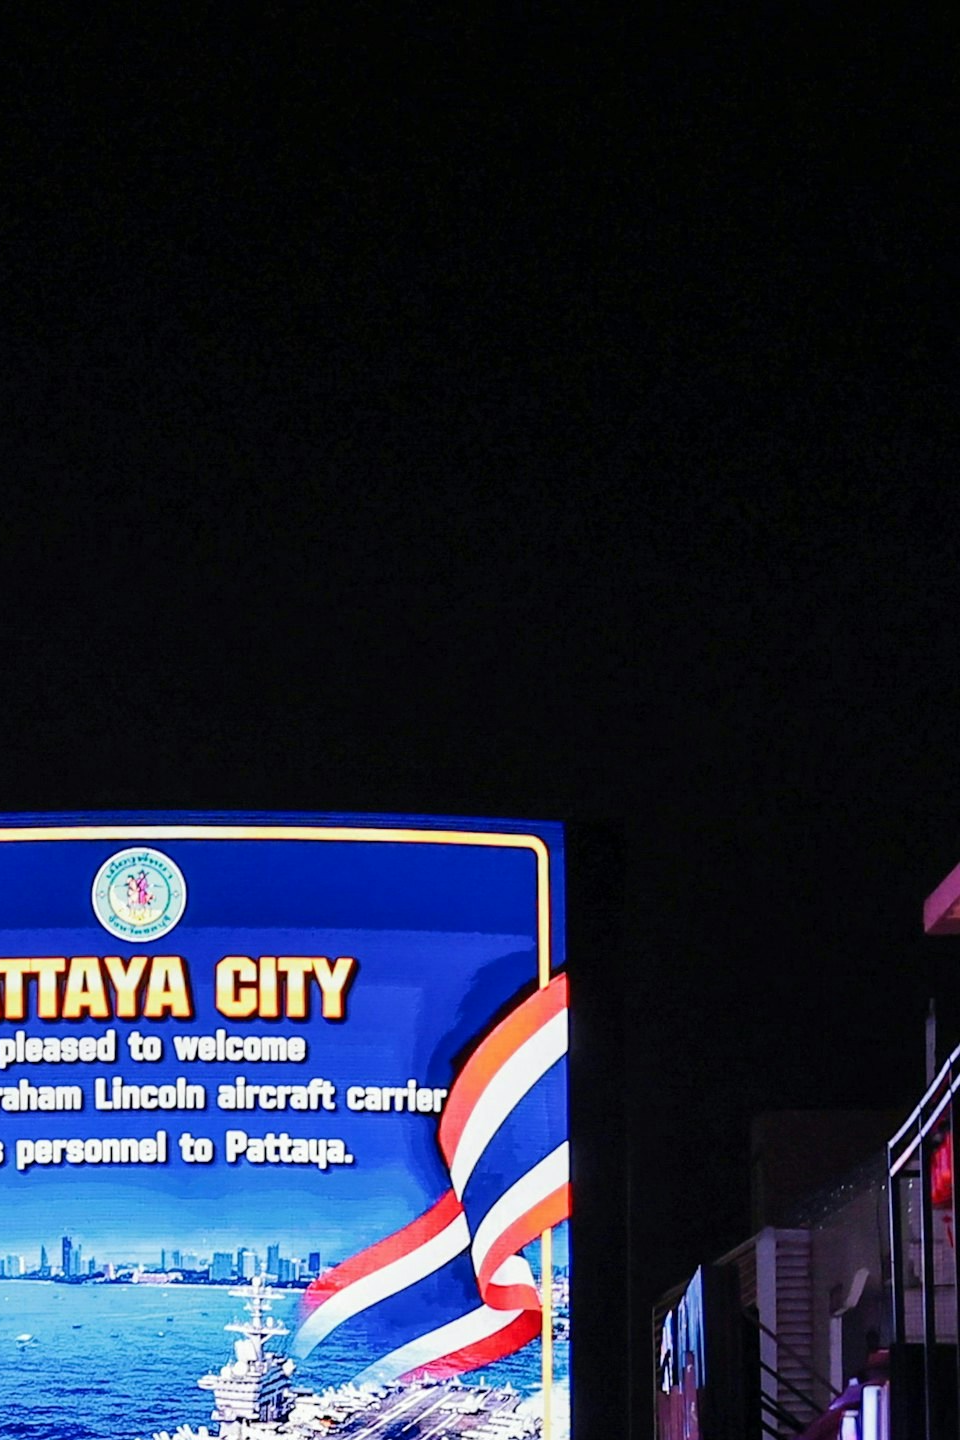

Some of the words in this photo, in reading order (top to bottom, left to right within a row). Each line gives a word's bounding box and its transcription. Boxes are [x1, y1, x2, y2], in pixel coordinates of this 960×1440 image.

[215, 956, 354, 1019] CITY
[127, 1030, 162, 1062] to
[173, 1028, 306, 1062] welcome
[94, 1076, 206, 1111] Lincoln
[217, 1076, 337, 1111] aircraft
[346, 1078, 447, 1113] carrier
[16, 1130, 167, 1171] personnel
[178, 1132, 214, 1164] to
[225, 1130, 354, 1170] Pattaya.
